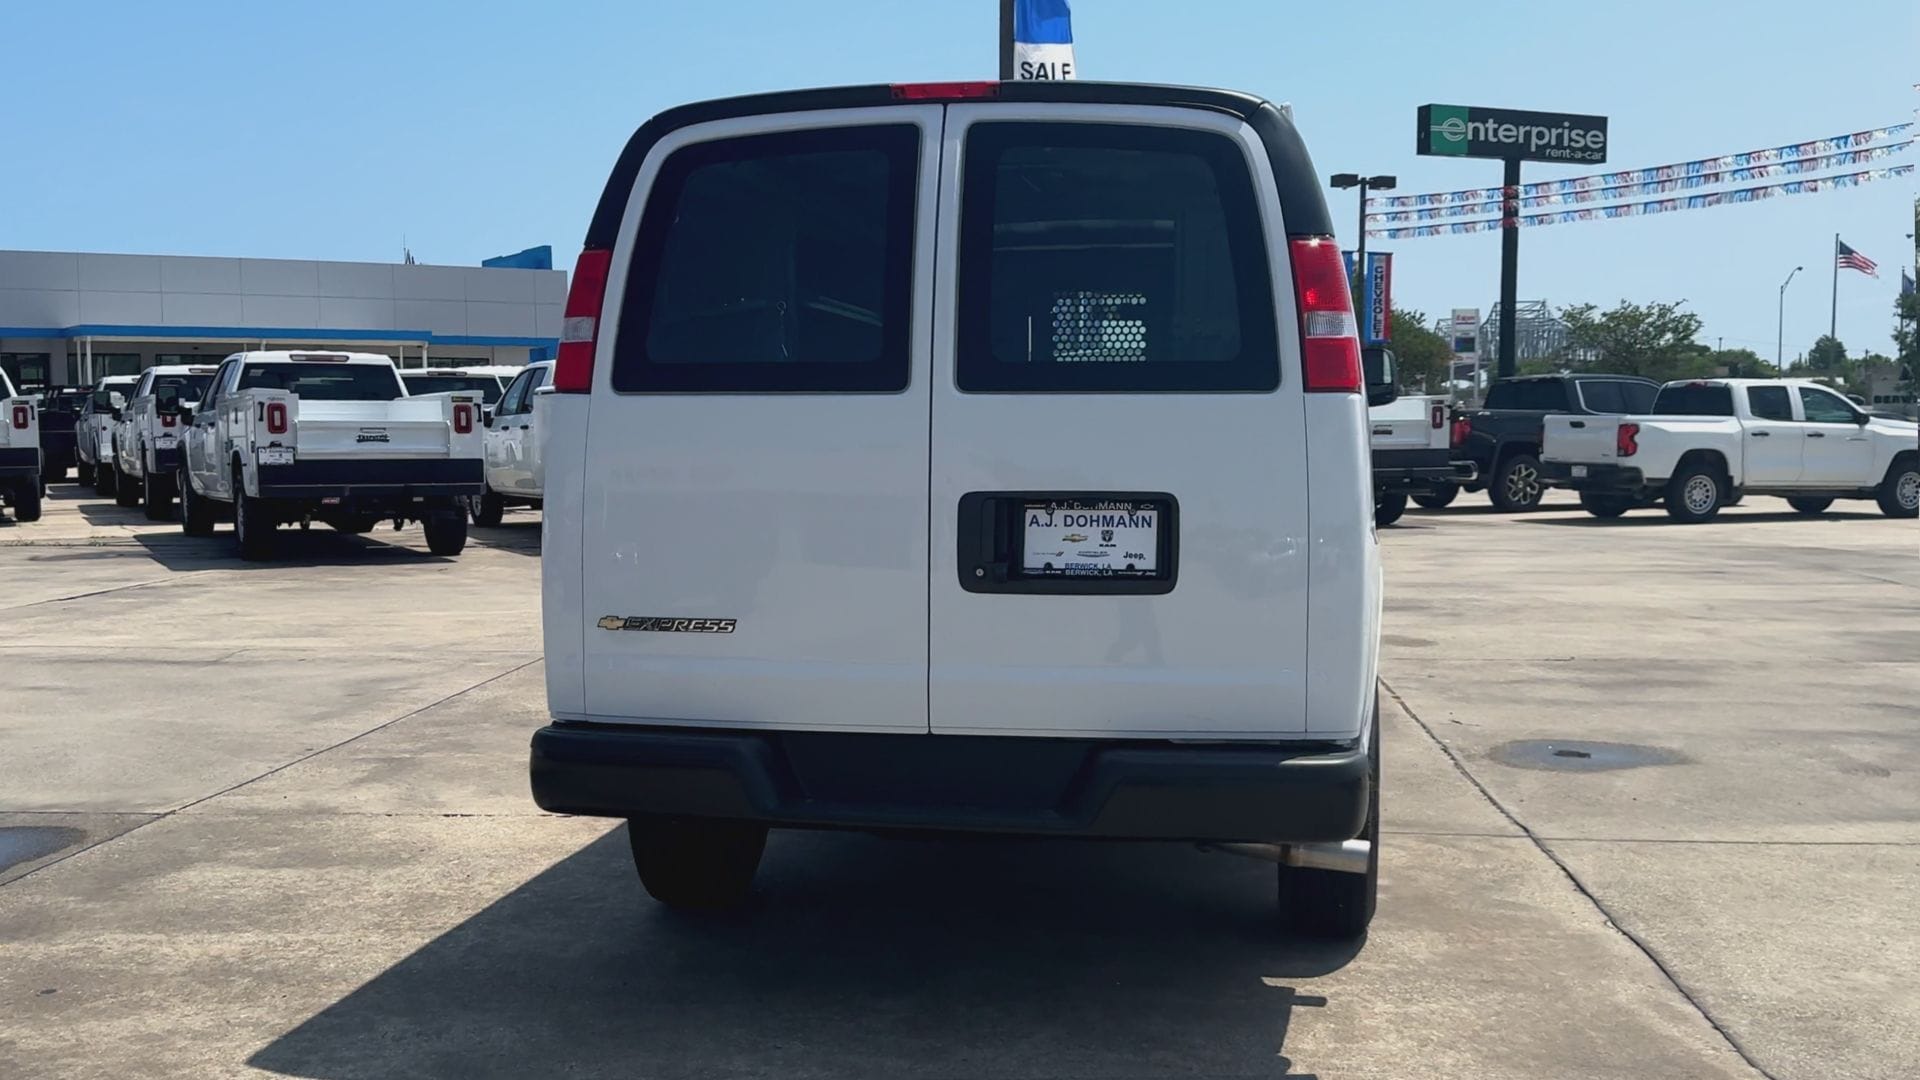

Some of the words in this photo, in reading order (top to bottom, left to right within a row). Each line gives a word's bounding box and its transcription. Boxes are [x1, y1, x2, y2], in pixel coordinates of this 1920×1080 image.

[1441, 117, 1605, 152] enterprise
[1545, 148, 1604, 160] rent-a-car
[1373, 265, 1384, 339] CHEVROLET
[1074, 501, 1132, 510] DMANN
[1028, 514, 1058, 528] A.J.
[1063, 514, 1152, 529] DOHMANN
[625, 617, 736, 632] EXPRESS
